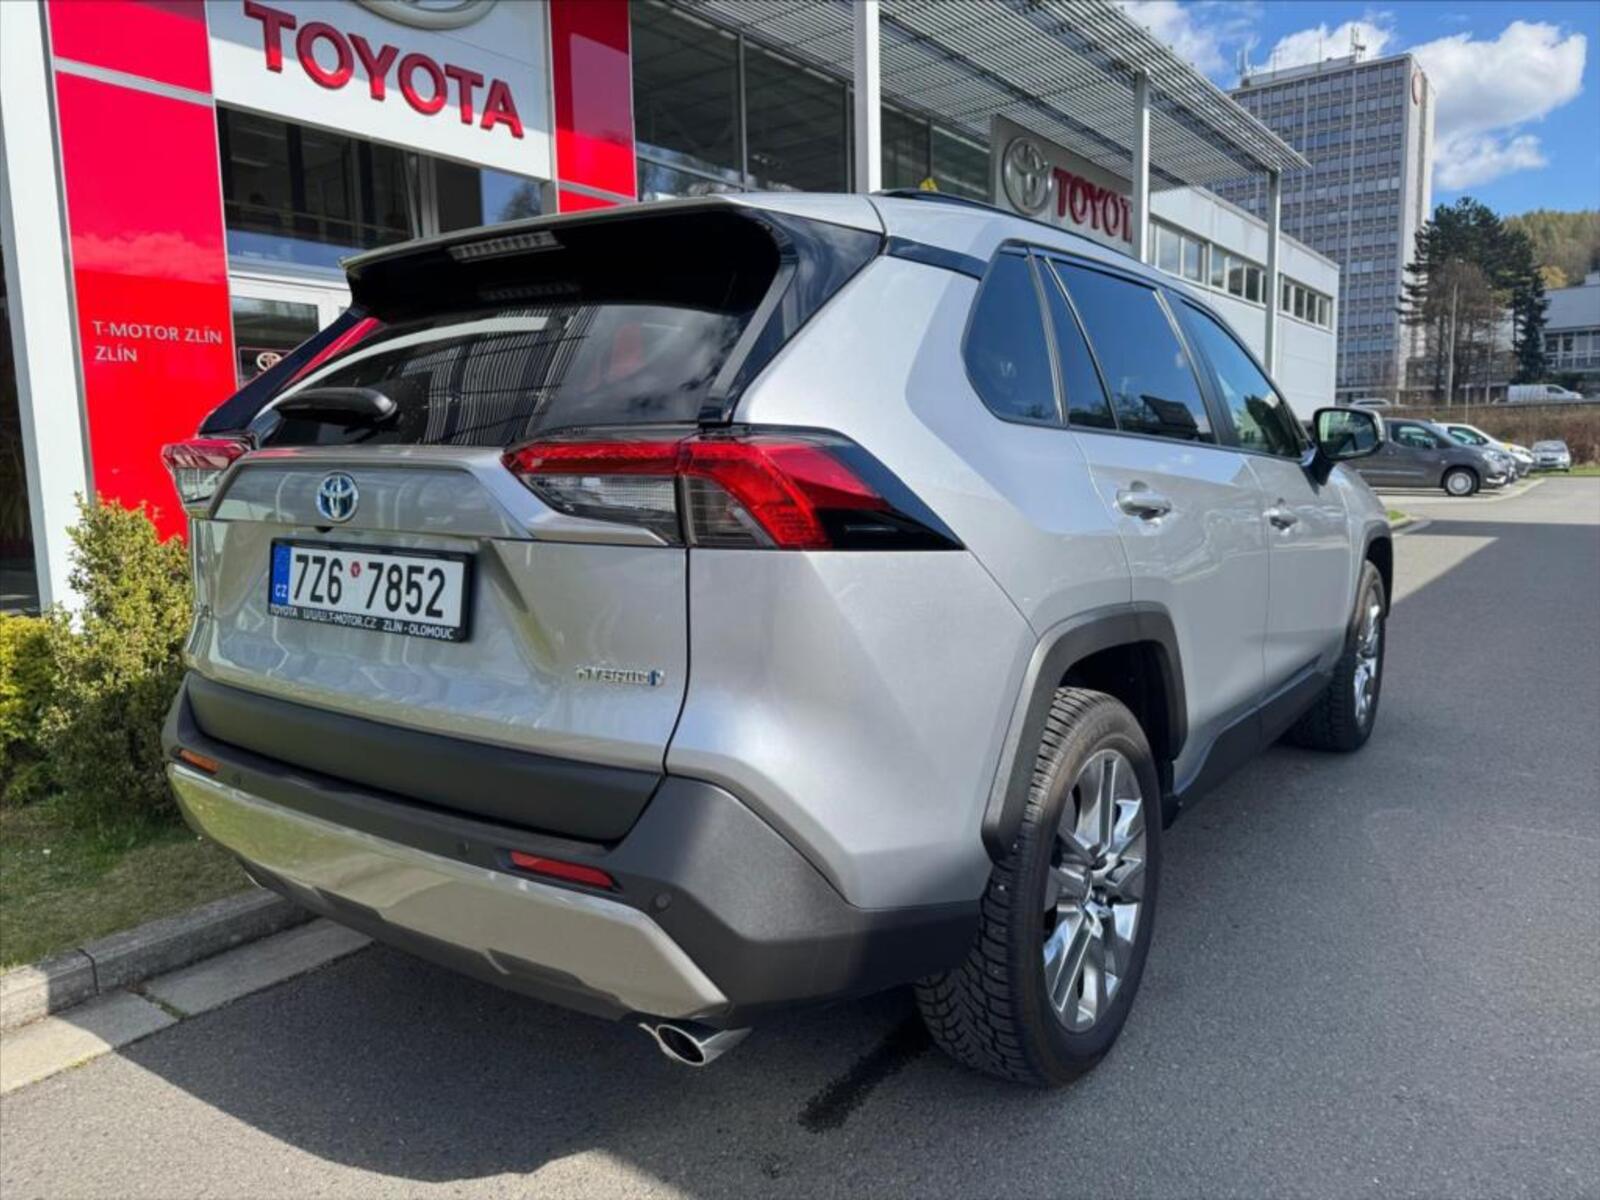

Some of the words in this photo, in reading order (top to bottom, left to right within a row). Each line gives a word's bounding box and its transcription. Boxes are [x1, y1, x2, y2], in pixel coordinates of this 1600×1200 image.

[244, 0, 524, 139] TOYOTA
[1053, 166, 1133, 244] TOYOT
[93, 320, 179, 341] T-MOTOR
[185, 326, 223, 345] ZLÍN
[95, 344, 138, 362] ZLÍN
[275, 584, 287, 598] CZ
[294, 554, 343, 605] 7Z6
[365, 561, 446, 618] 7852
[408, 623, 455, 640] OLOMOUC
